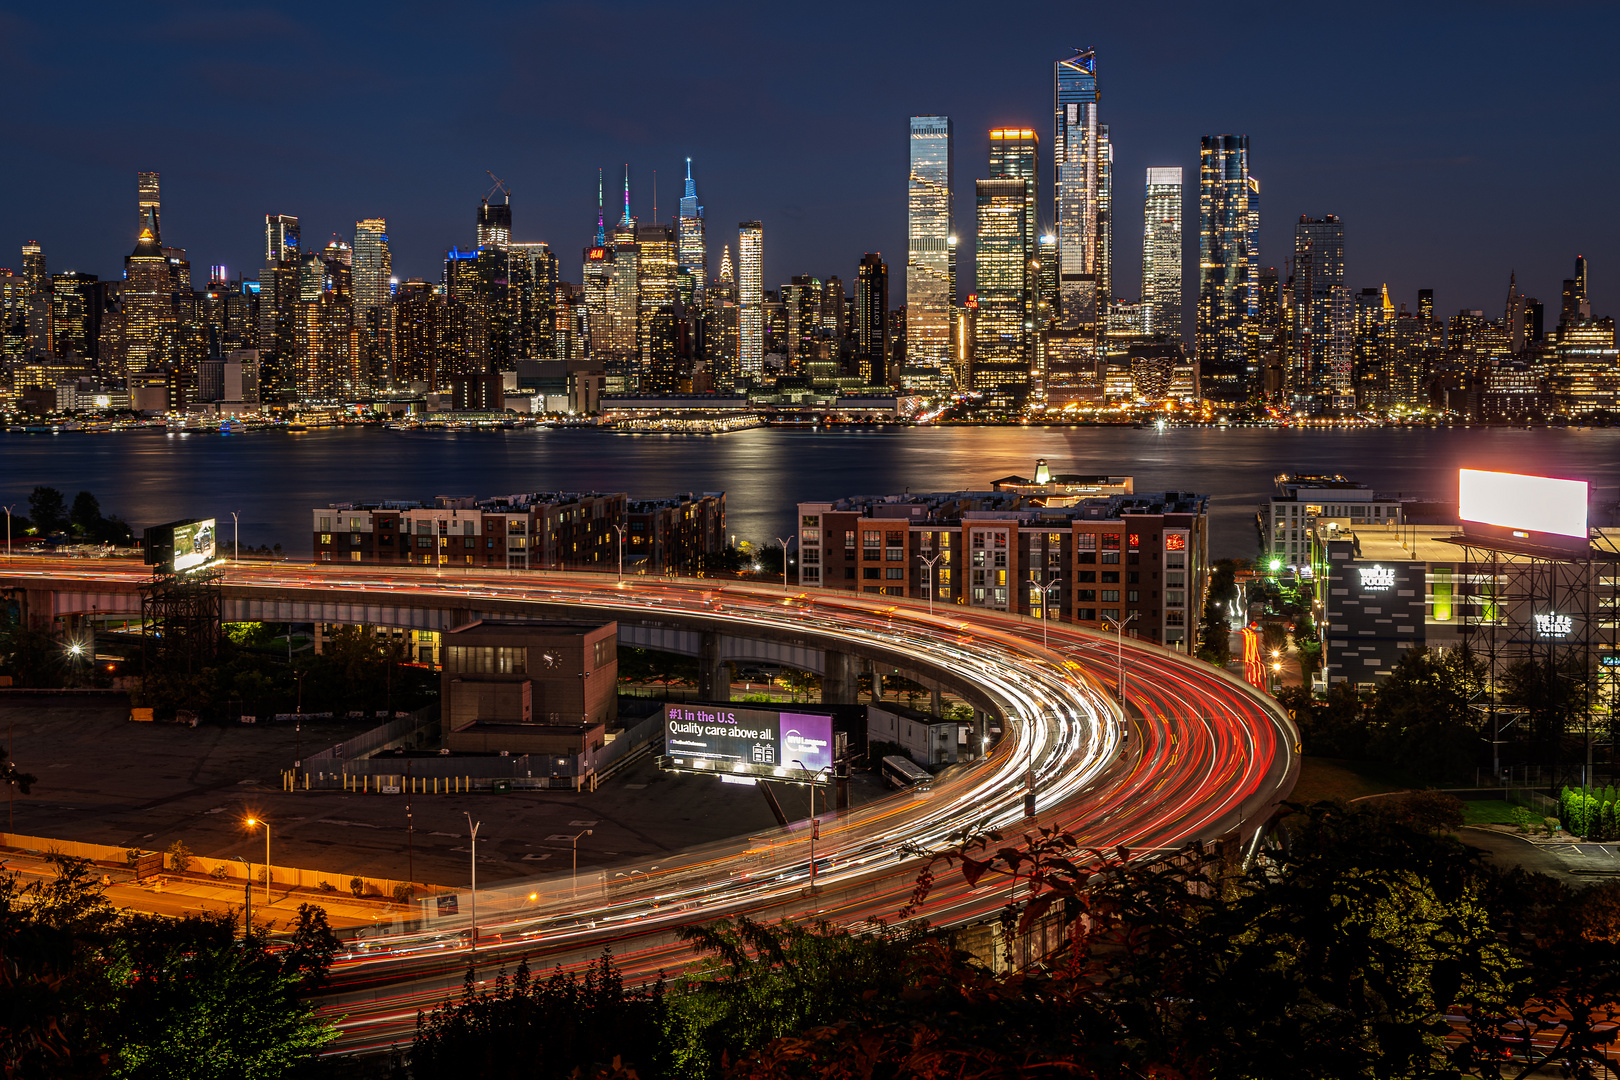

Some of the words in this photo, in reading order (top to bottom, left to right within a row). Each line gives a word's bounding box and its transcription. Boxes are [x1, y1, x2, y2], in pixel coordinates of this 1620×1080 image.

[1360, 577, 1395, 586] FOODS
[669, 708, 683, 720] #1
[684, 709, 695, 721] in
[696, 711, 715, 722] the
[717, 712, 738, 725] U.S.
[669, 720, 704, 737] Quality
[704, 726, 727, 736] care
[728, 727, 758, 739] above
[759, 728, 774, 740] all.
[787, 735, 801, 744] NYU
